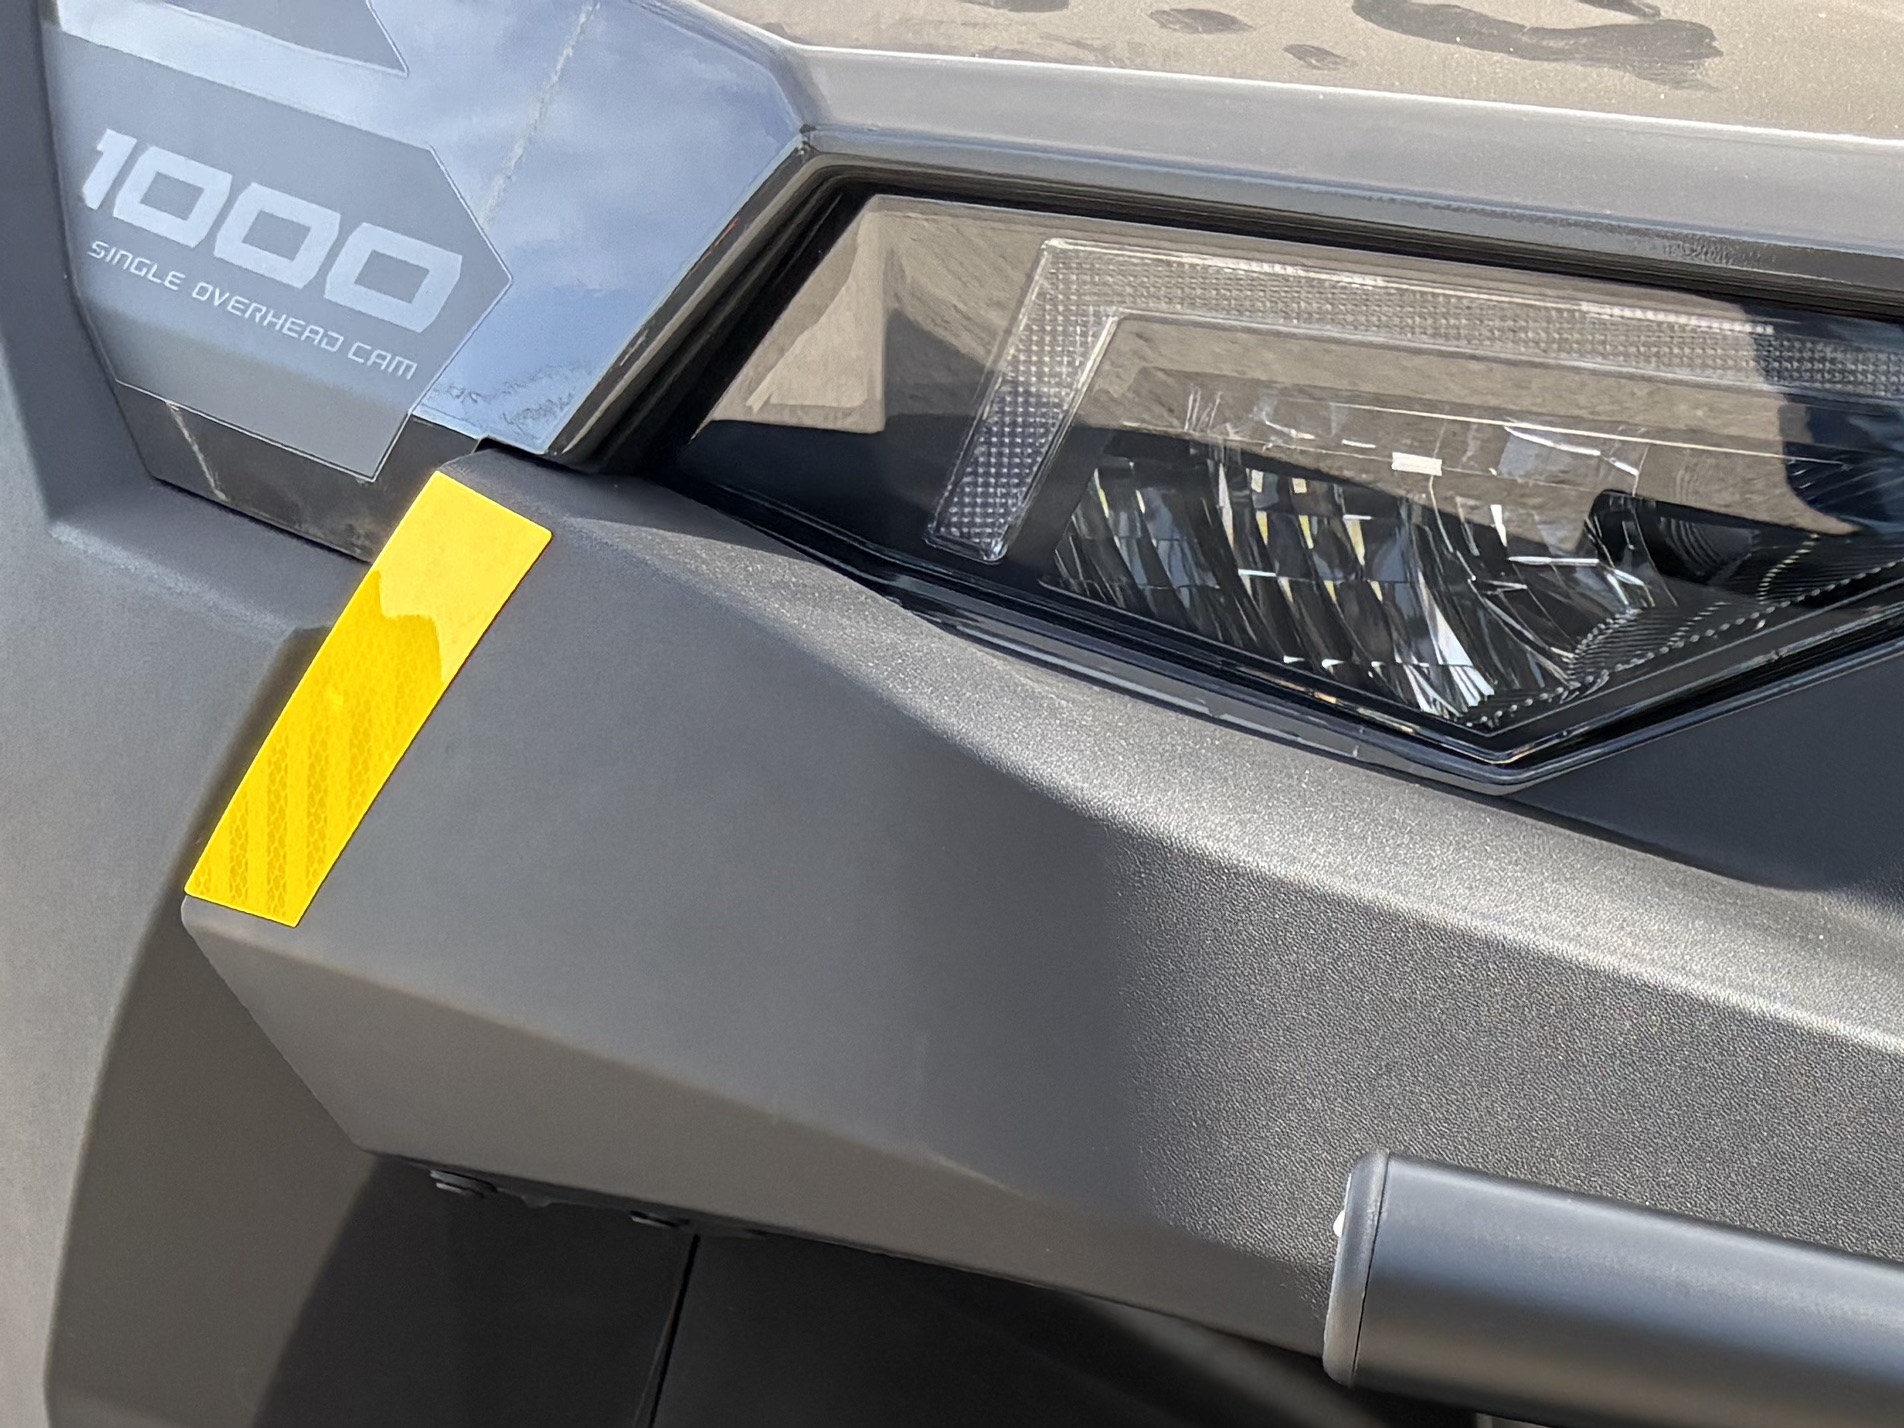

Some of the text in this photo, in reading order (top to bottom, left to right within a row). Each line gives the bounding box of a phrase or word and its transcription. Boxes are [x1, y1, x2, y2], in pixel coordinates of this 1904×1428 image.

[82, 128, 463, 333] 1000
[87, 240, 418, 381] SINGLE OVERHEAD CAM
